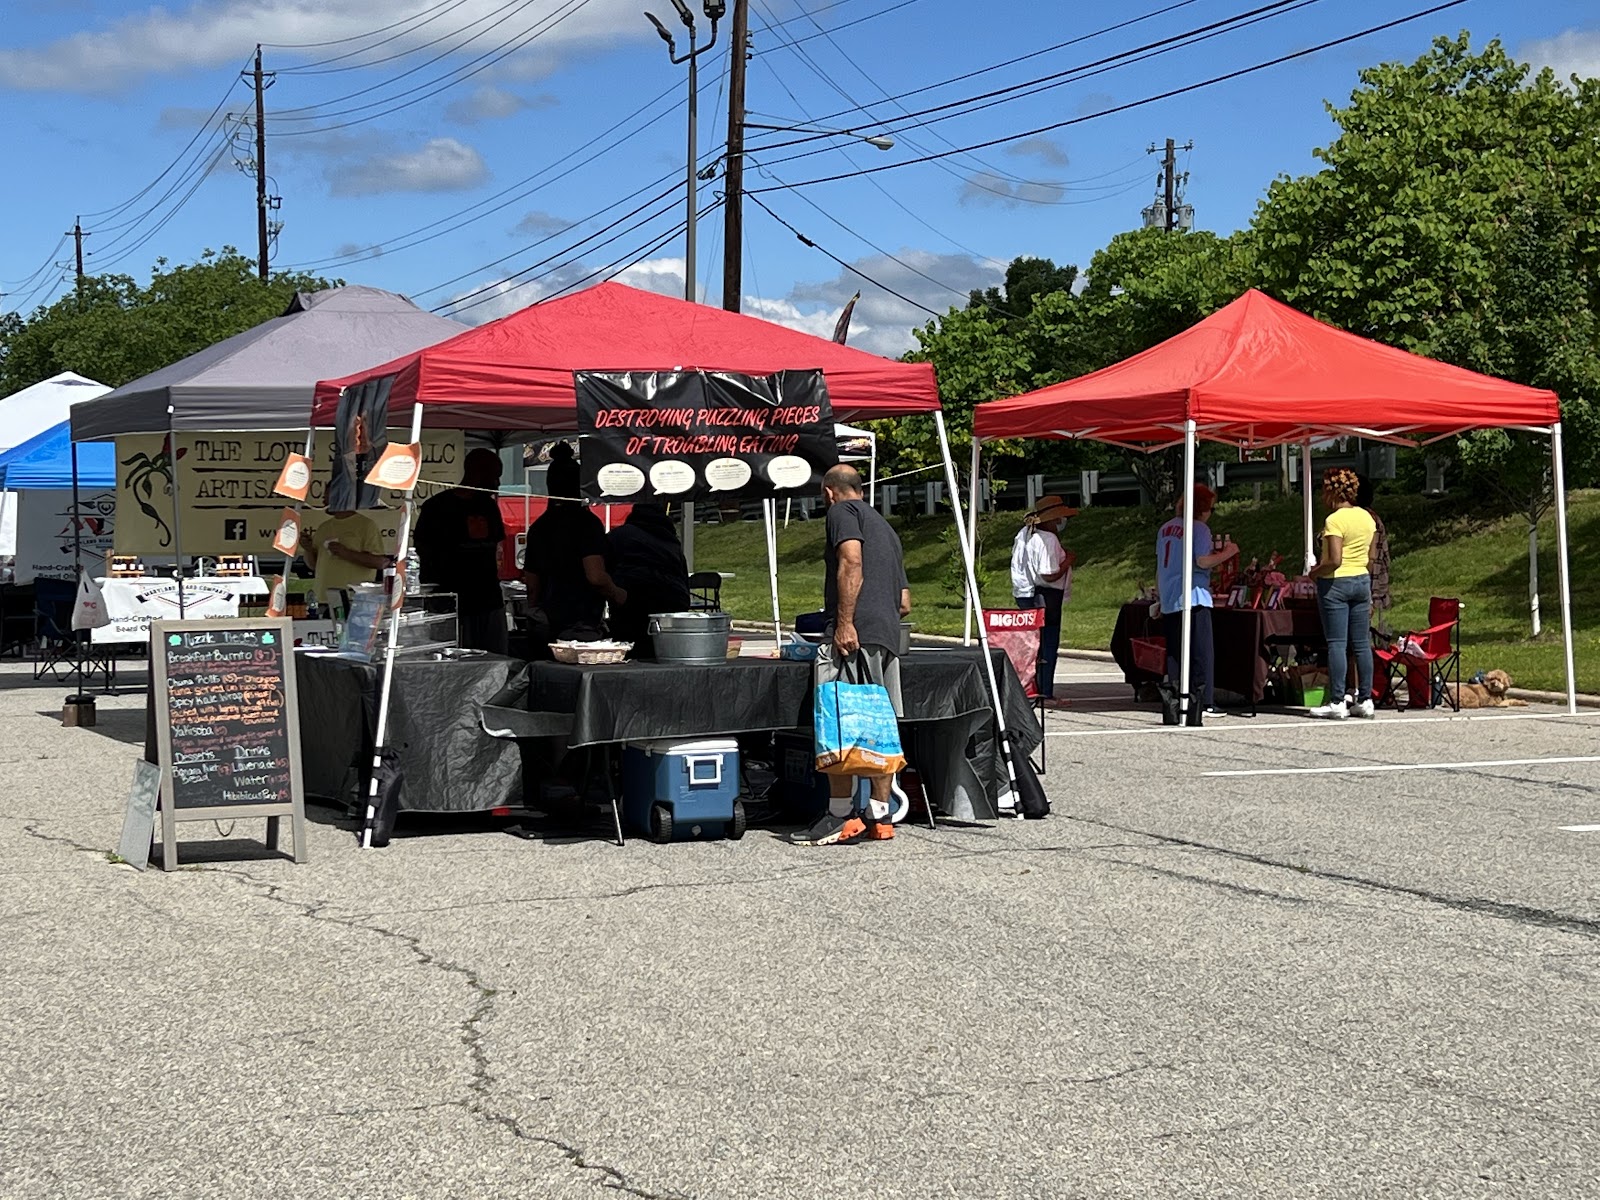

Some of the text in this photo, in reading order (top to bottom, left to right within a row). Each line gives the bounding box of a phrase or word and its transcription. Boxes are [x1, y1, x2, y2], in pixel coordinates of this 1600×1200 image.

[595, 405, 820, 430] DESTROYING PUZZLING PIECES
[195, 440, 242, 461] THE
[626, 434, 798, 456] OF TROUBLING EATING
[195, 479, 290, 499] ARTIS
[144, 586, 176, 597] MARYLAND
[233, 775, 269, 787] Water
